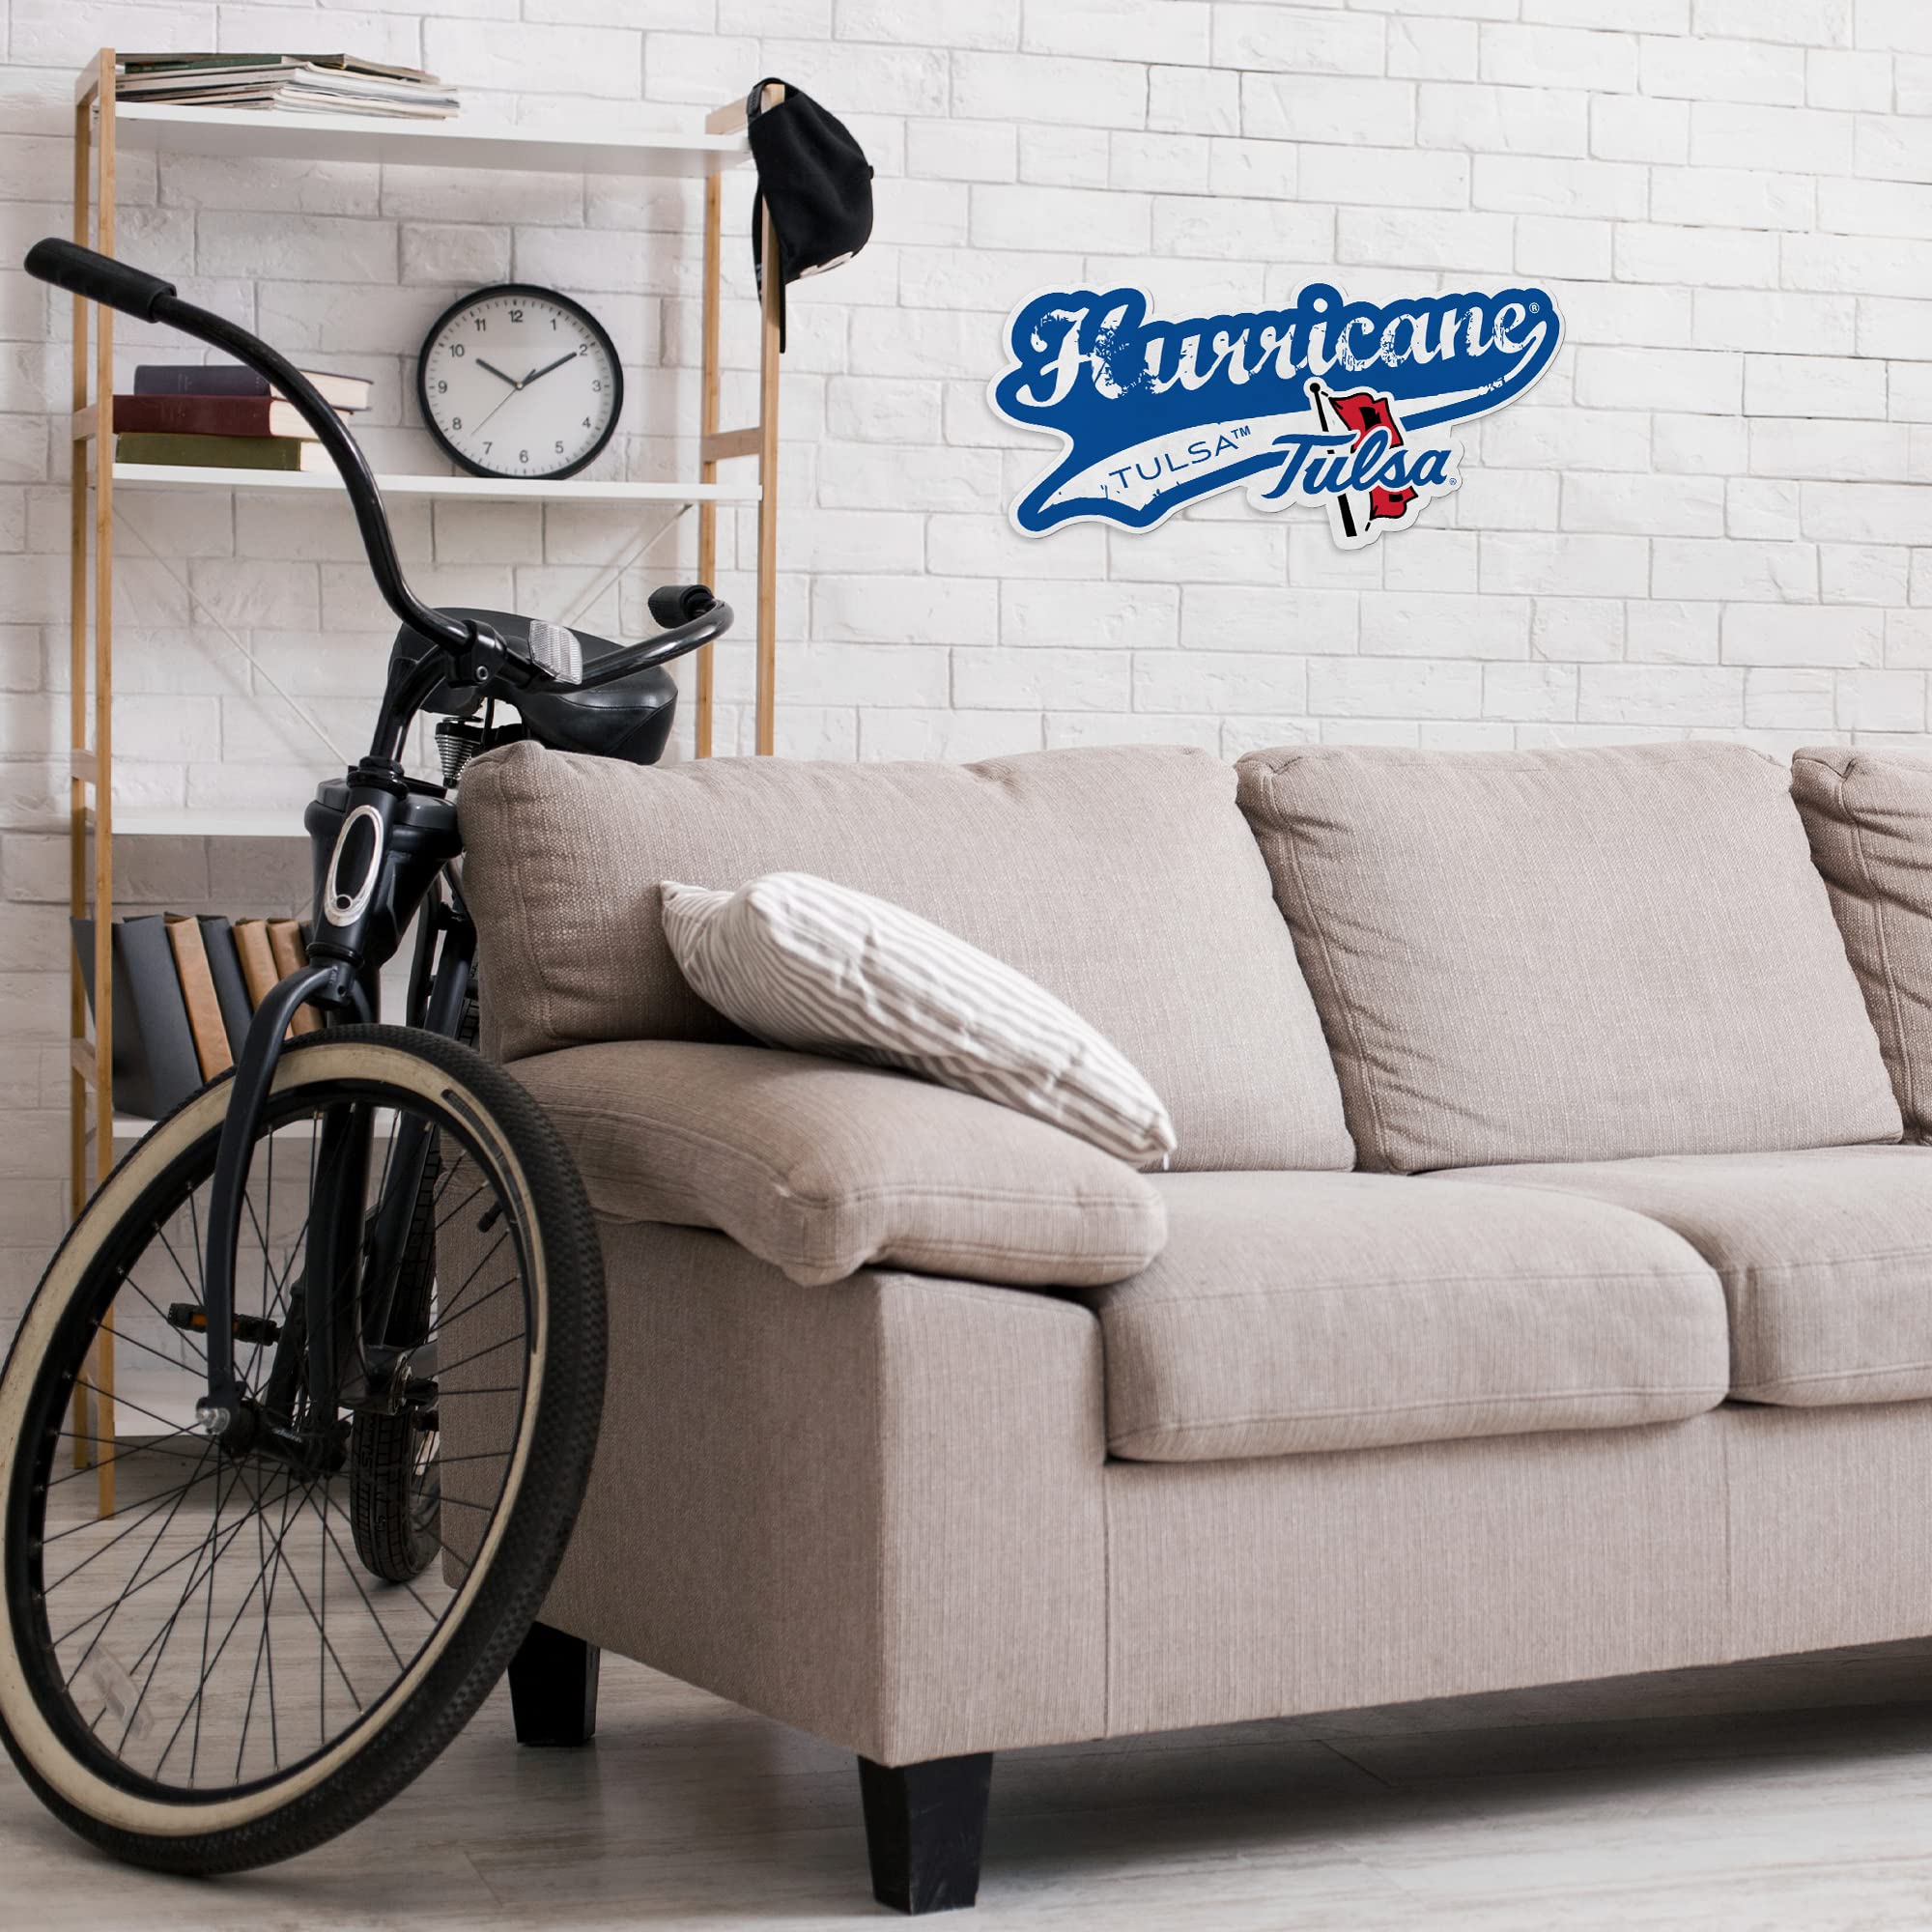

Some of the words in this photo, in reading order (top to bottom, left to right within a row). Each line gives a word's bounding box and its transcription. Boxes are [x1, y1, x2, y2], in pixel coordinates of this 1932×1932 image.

[508, 310, 524, 324] 12
[474, 319, 487, 331] 11
[551, 319, 557, 331] 1
[449, 344, 466, 357] 10
[580, 344, 588, 356] 2
[438, 381, 448, 394] 9
[592, 381, 601, 392] 3
[452, 417, 462, 431] 8
[582, 416, 592, 429] 4
[483, 441, 493, 455] 7
[554, 440, 564, 454] 5
[519, 450, 528, 464] 6
